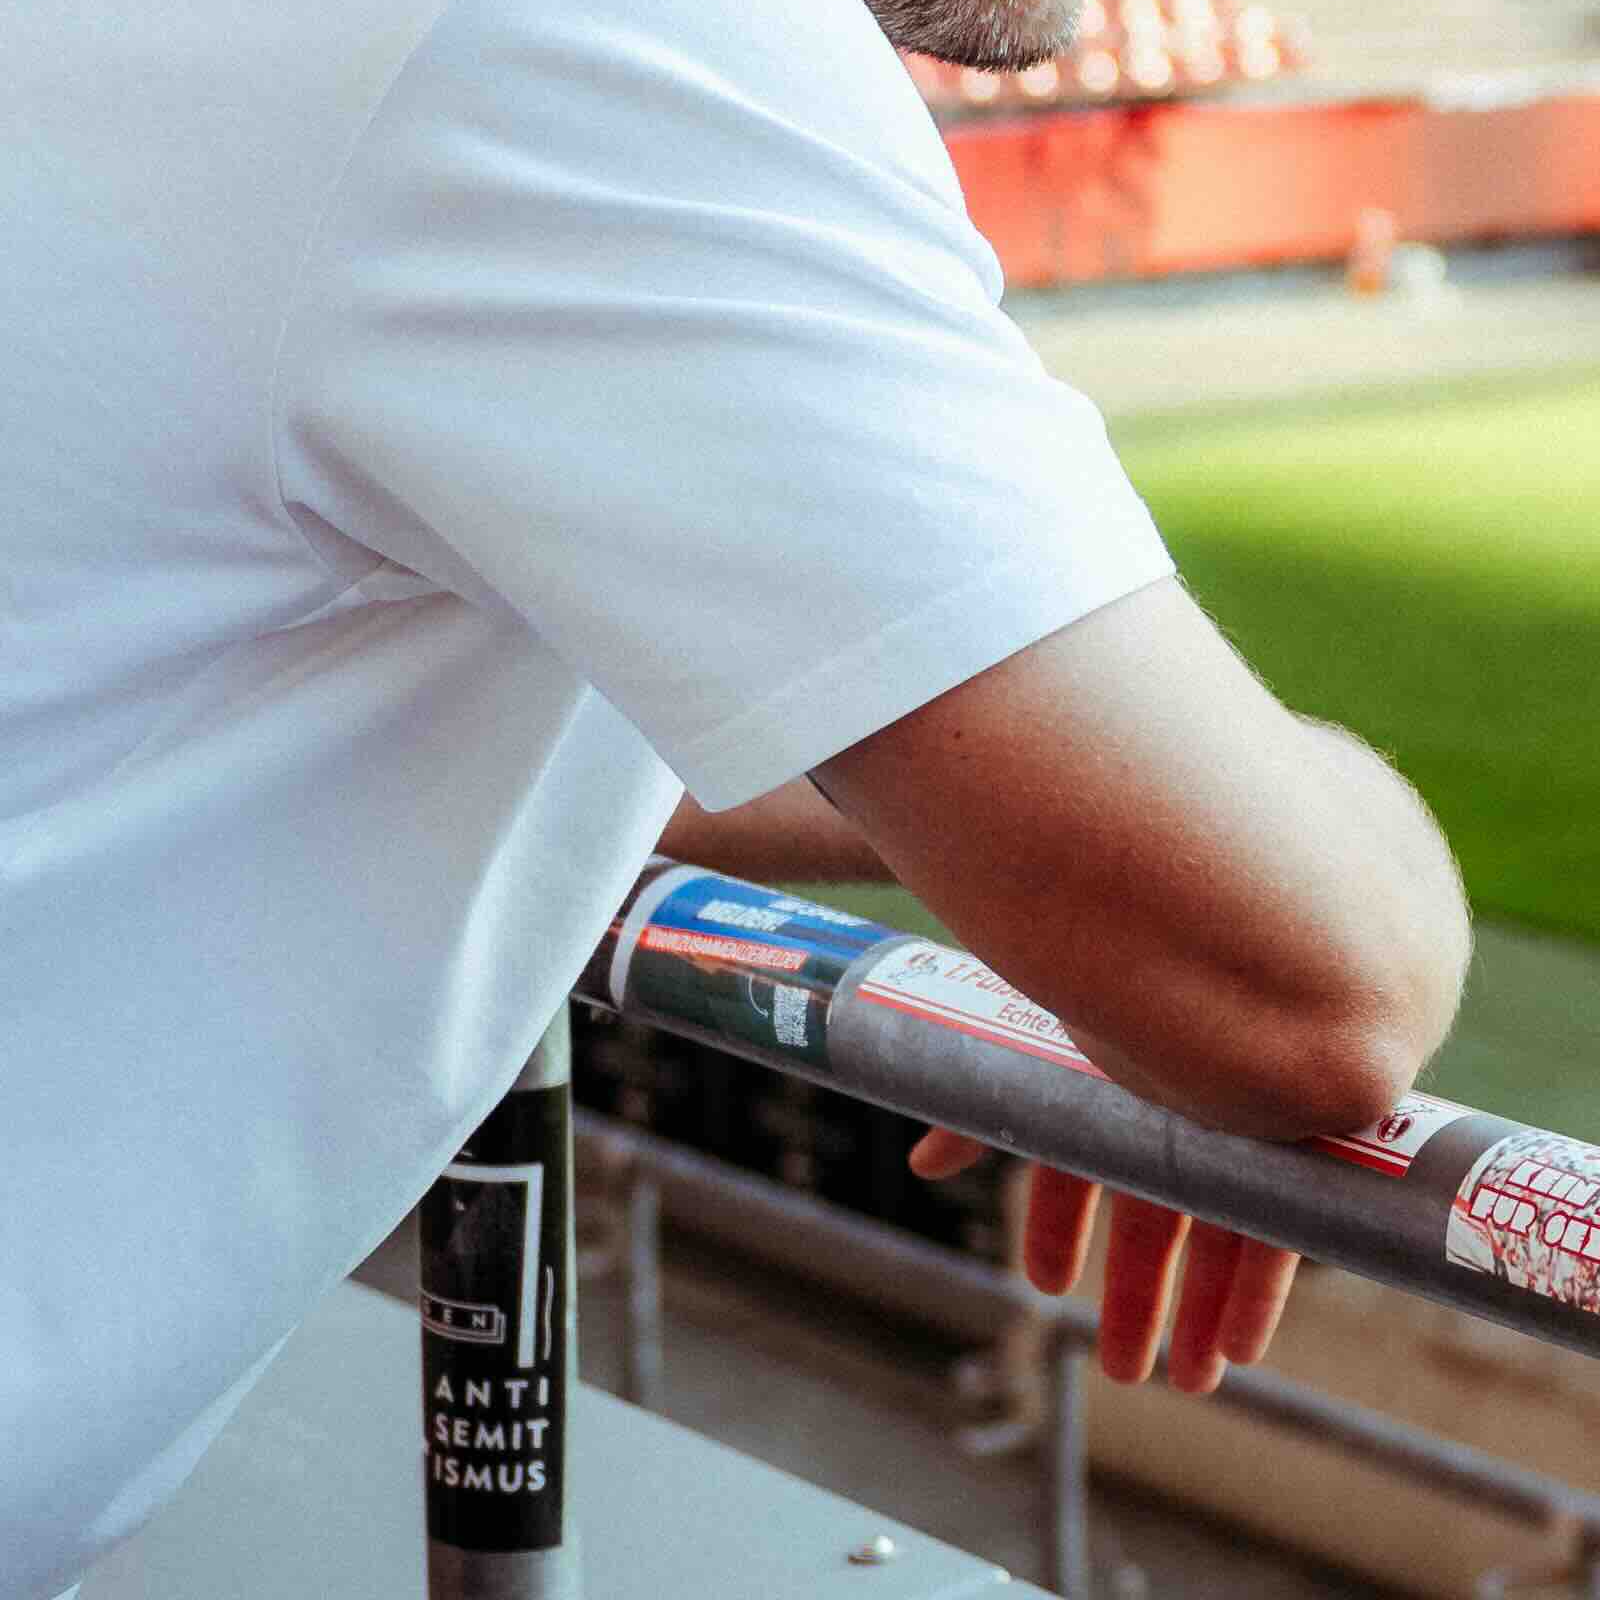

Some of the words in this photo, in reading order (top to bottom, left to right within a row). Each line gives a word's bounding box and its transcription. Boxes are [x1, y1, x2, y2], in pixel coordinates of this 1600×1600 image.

[997, 1002, 1050, 1032] Echte
[434, 1373, 549, 1409] ANTI
[435, 1411, 550, 1451] SEMIT
[433, 1453, 546, 1493] ISMUS
